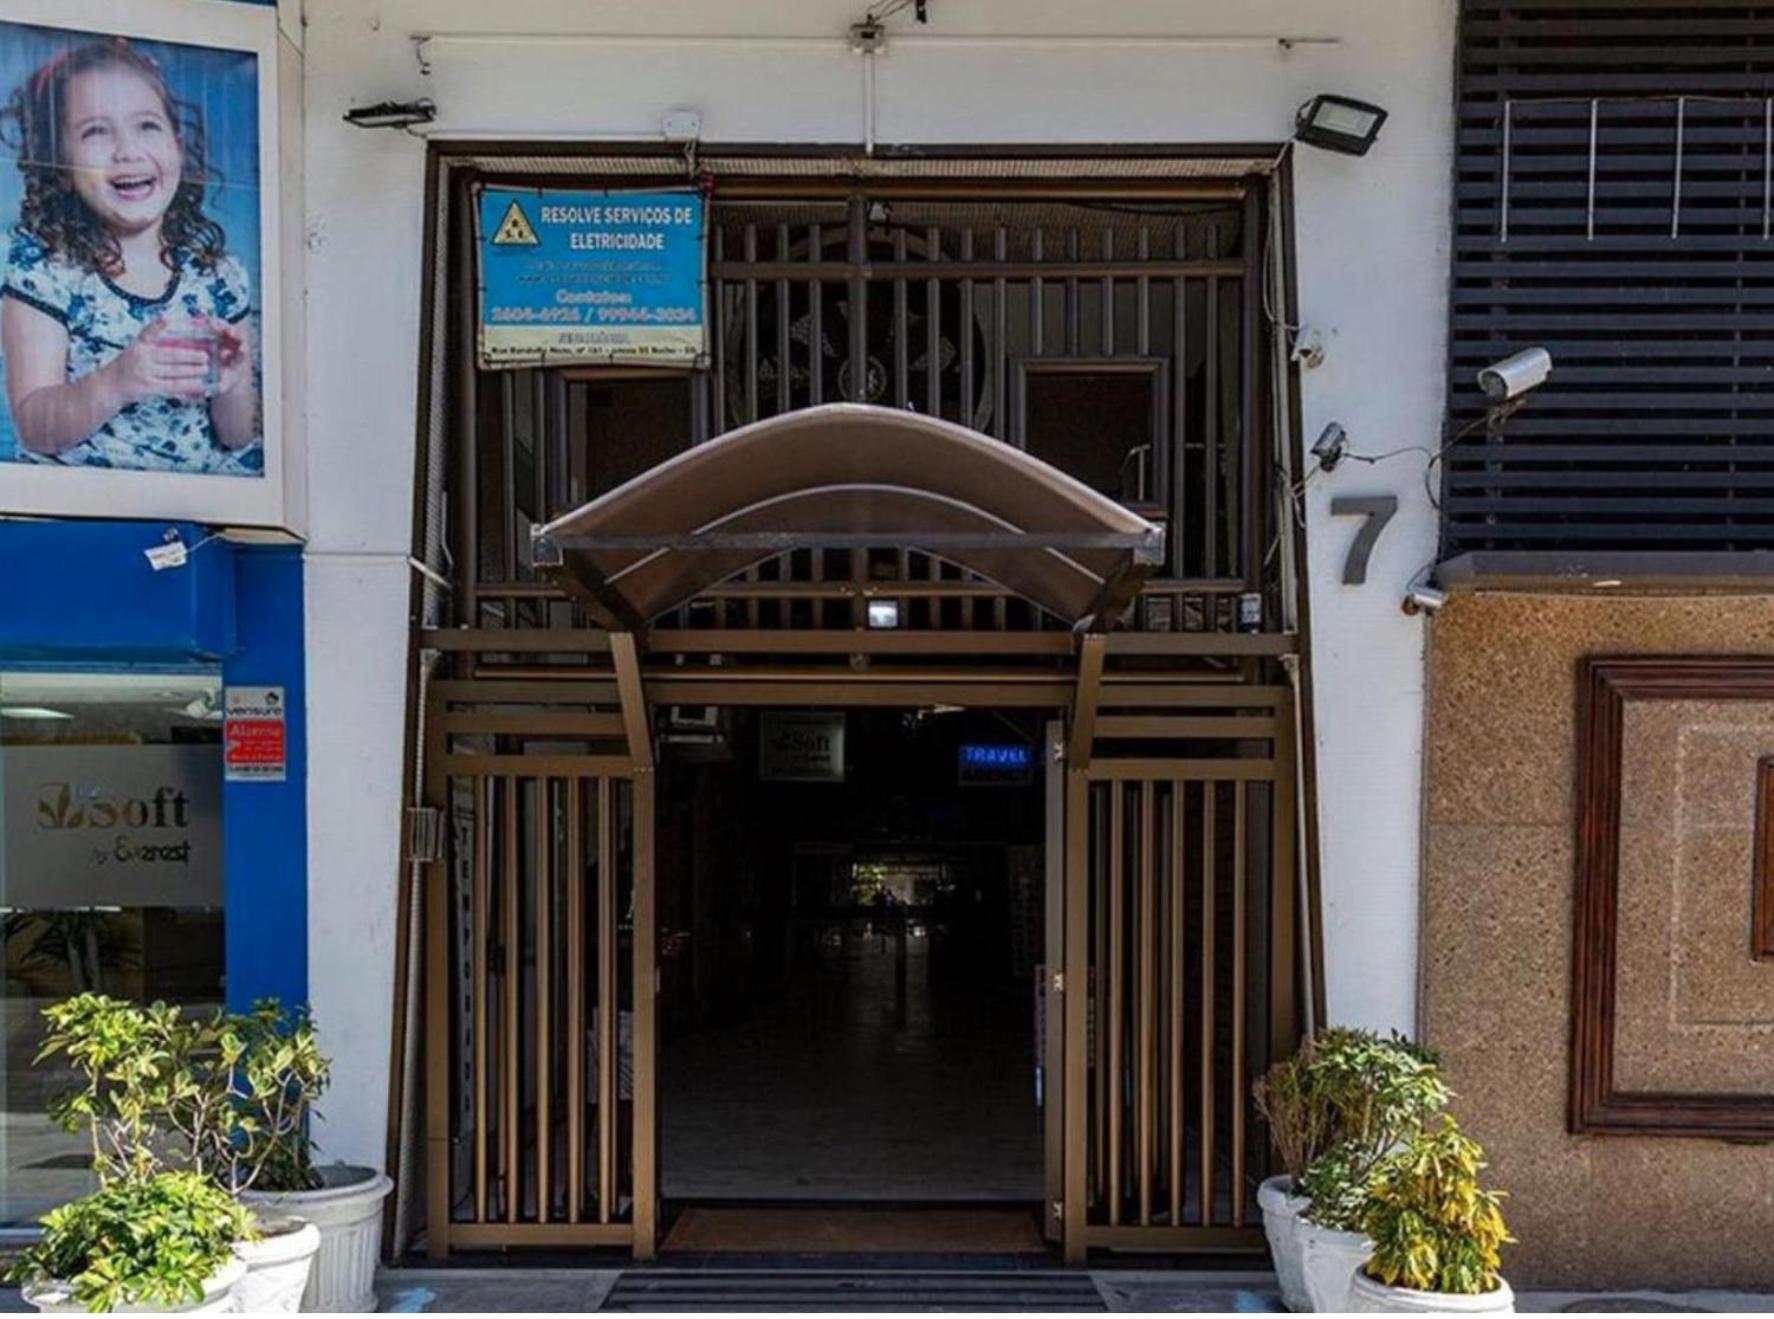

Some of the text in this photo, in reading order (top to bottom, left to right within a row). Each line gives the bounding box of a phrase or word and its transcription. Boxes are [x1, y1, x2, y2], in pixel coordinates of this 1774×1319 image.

[541, 206, 693, 225] RESOLVE SERVIÇOS DE
[570, 233, 666, 250] ELETRICIDADE
[1330, 495, 1399, 586] 7
[962, 744, 1027, 763] TRAVEL
[87, 785, 190, 828] Soft
